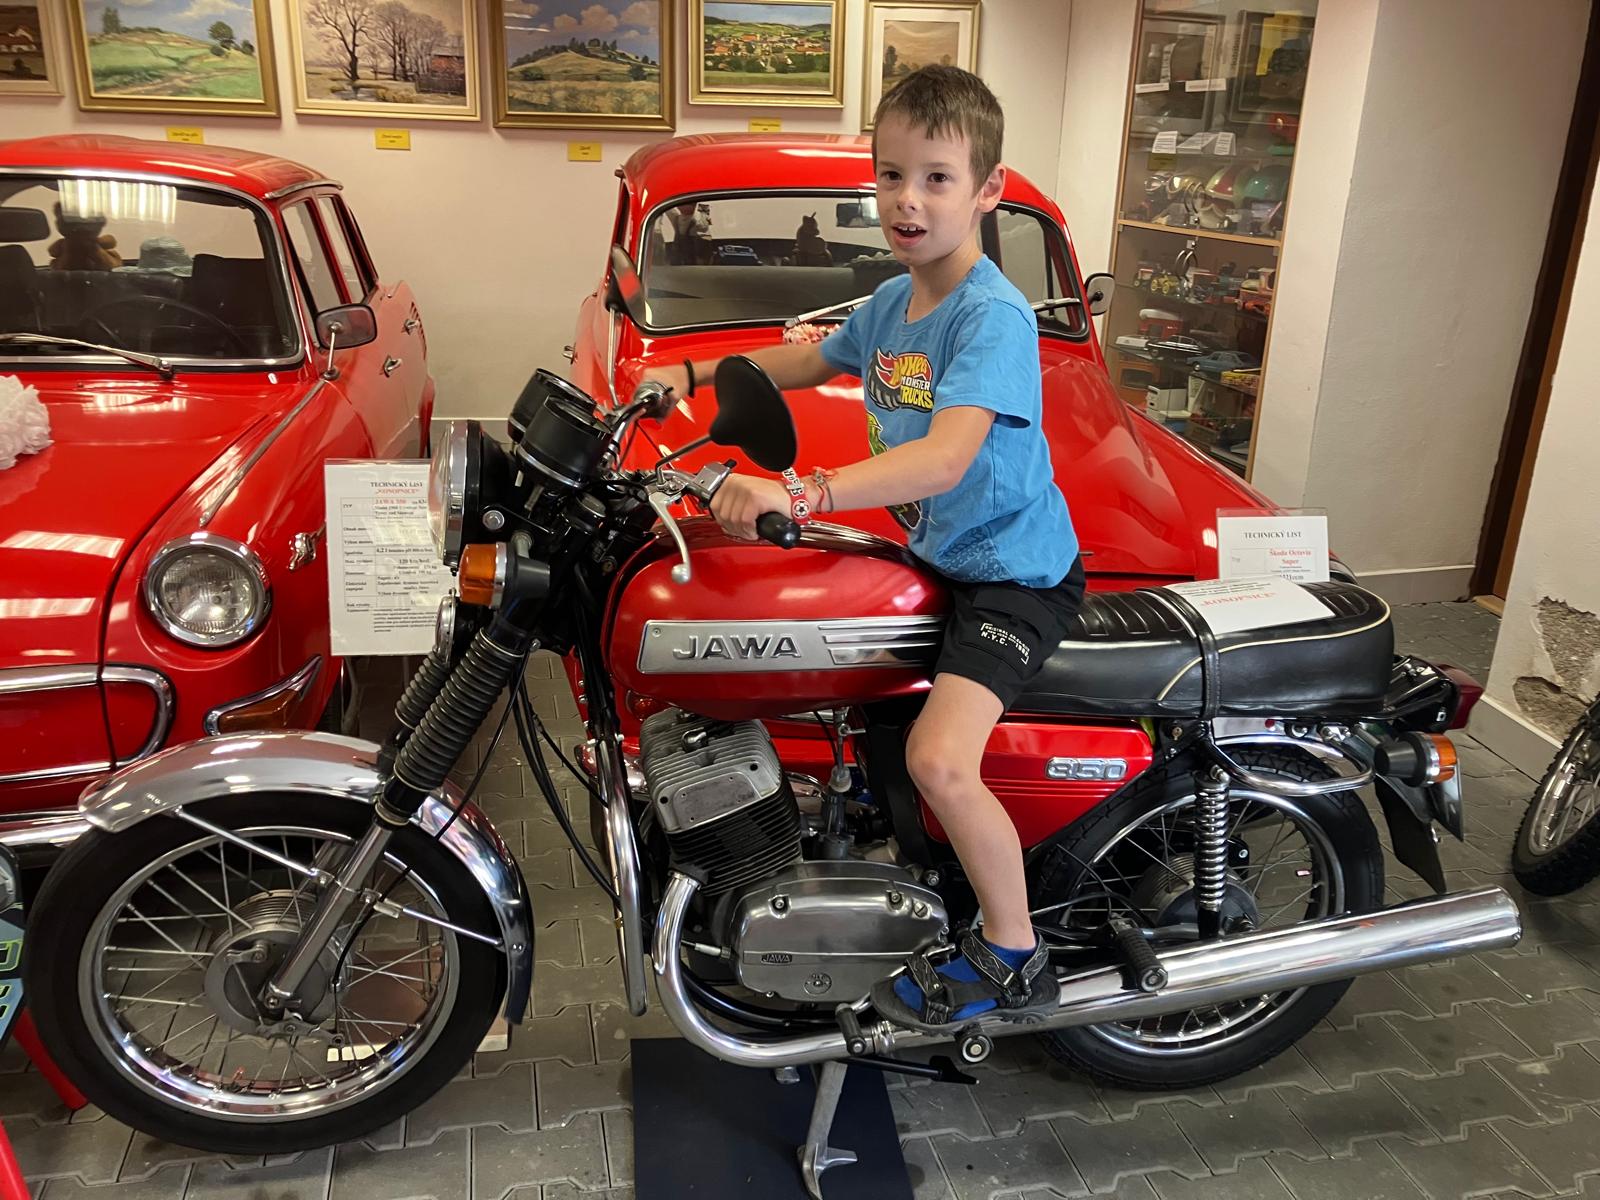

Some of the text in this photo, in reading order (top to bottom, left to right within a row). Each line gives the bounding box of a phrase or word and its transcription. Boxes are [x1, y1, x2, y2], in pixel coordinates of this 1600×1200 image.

[901, 375, 931, 391] MONSTER
[900, 385, 934, 409] TRUCKS
[672, 634, 802, 660] JAWA
[980, 630, 1008, 646] N.Y.C.
[1047, 757, 1128, 780] 350
[762, 954, 791, 963] JAWA
